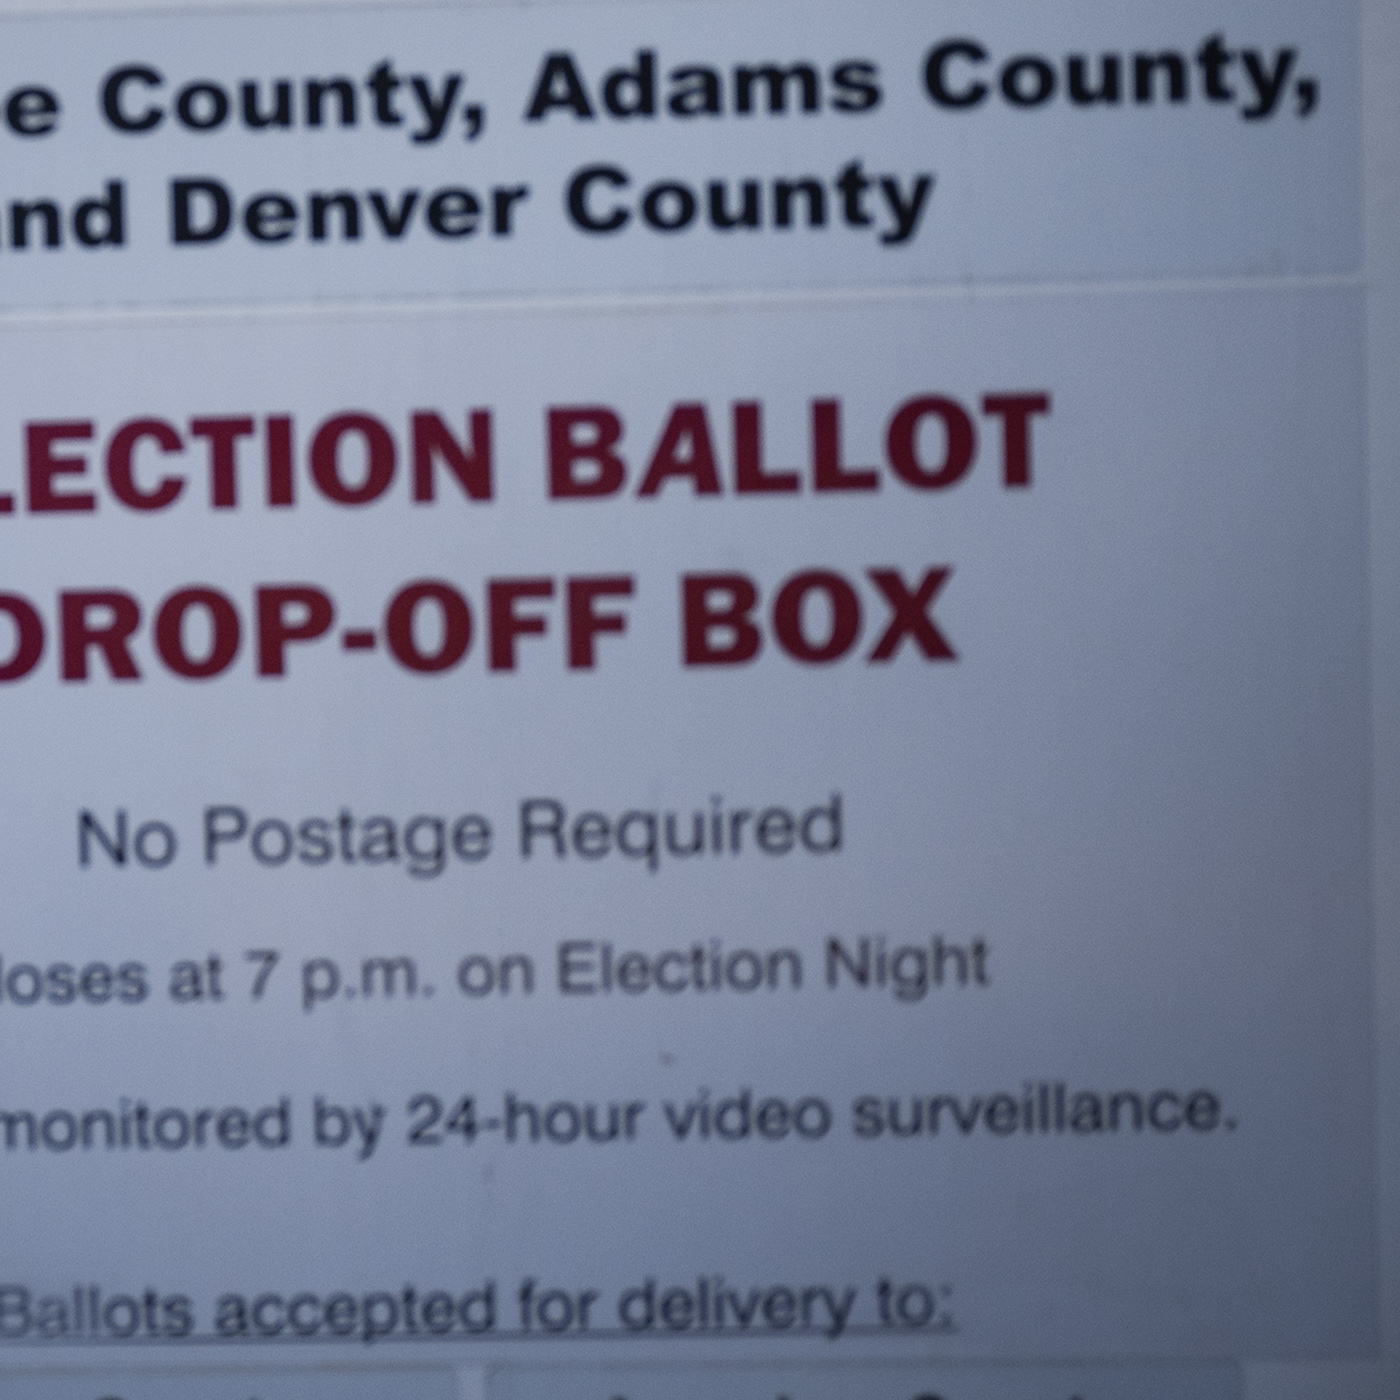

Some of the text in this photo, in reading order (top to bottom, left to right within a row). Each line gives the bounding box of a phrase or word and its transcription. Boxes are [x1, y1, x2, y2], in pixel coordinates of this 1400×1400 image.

[97, 59, 488, 149] County,
[522, 49, 886, 126] Adams
[919, 34, 1322, 123] County,
[167, 163, 532, 250] Denver
[563, 150, 936, 250] County
[545, 393, 1052, 501] BALLOT
[680, 567, 958, 669] BOX
[76, 792, 844, 880] No Postage Required
[167, 953, 225, 1006] at
[245, 948, 281, 1001] 7
[300, 955, 435, 1012] p.m.
[455, 953, 536, 999] on
[555, 938, 804, 997] Election
[824, 934, 991, 1005] Night
[312, 1096, 387, 1162] by
[405, 1092, 646, 1147] 24-hour
[662, 1088, 834, 1143] video
[851, 1080, 1238, 1140] surveillance.
[213, 1277, 498, 1346] accepted
[518, 1275, 600, 1333] for
[616, 1274, 859, 1341] delivery
[875, 1275, 956, 1334] to:
